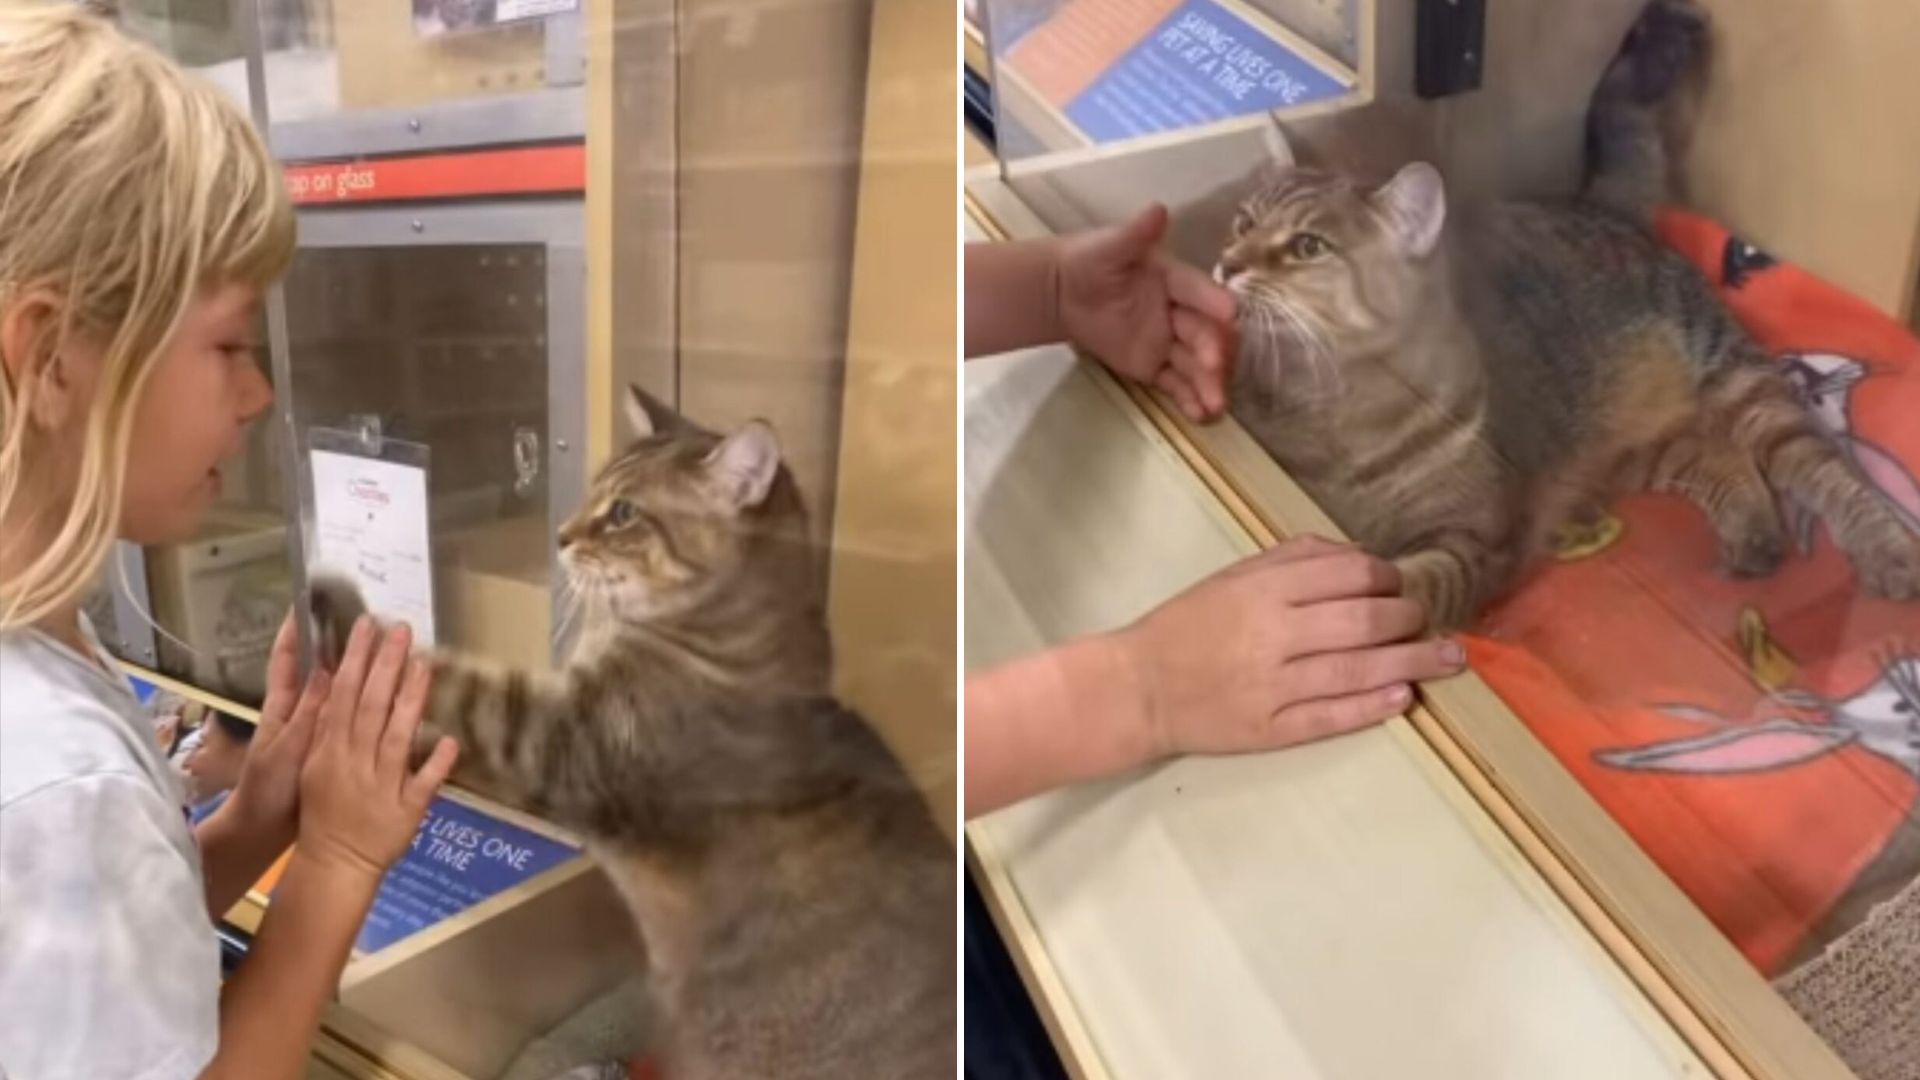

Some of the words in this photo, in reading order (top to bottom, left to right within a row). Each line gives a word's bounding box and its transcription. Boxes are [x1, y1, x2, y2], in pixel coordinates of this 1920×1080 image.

[1158, 26, 1191, 49] PET
[1180, 45, 1211, 64] AT
[1198, 58, 1219, 74] A
[1213, 63, 1257, 101] TIME
[1178, 11, 1235, 55] SAVING
[1225, 43, 1272, 78] LIVES
[1262, 69, 1307, 104] ONE
[313, 172, 332, 192] on
[336, 164, 375, 198] glass
[425, 837, 476, 872] TIME
[430, 815, 484, 848] LIVES
[482, 837, 534, 872] ONE
